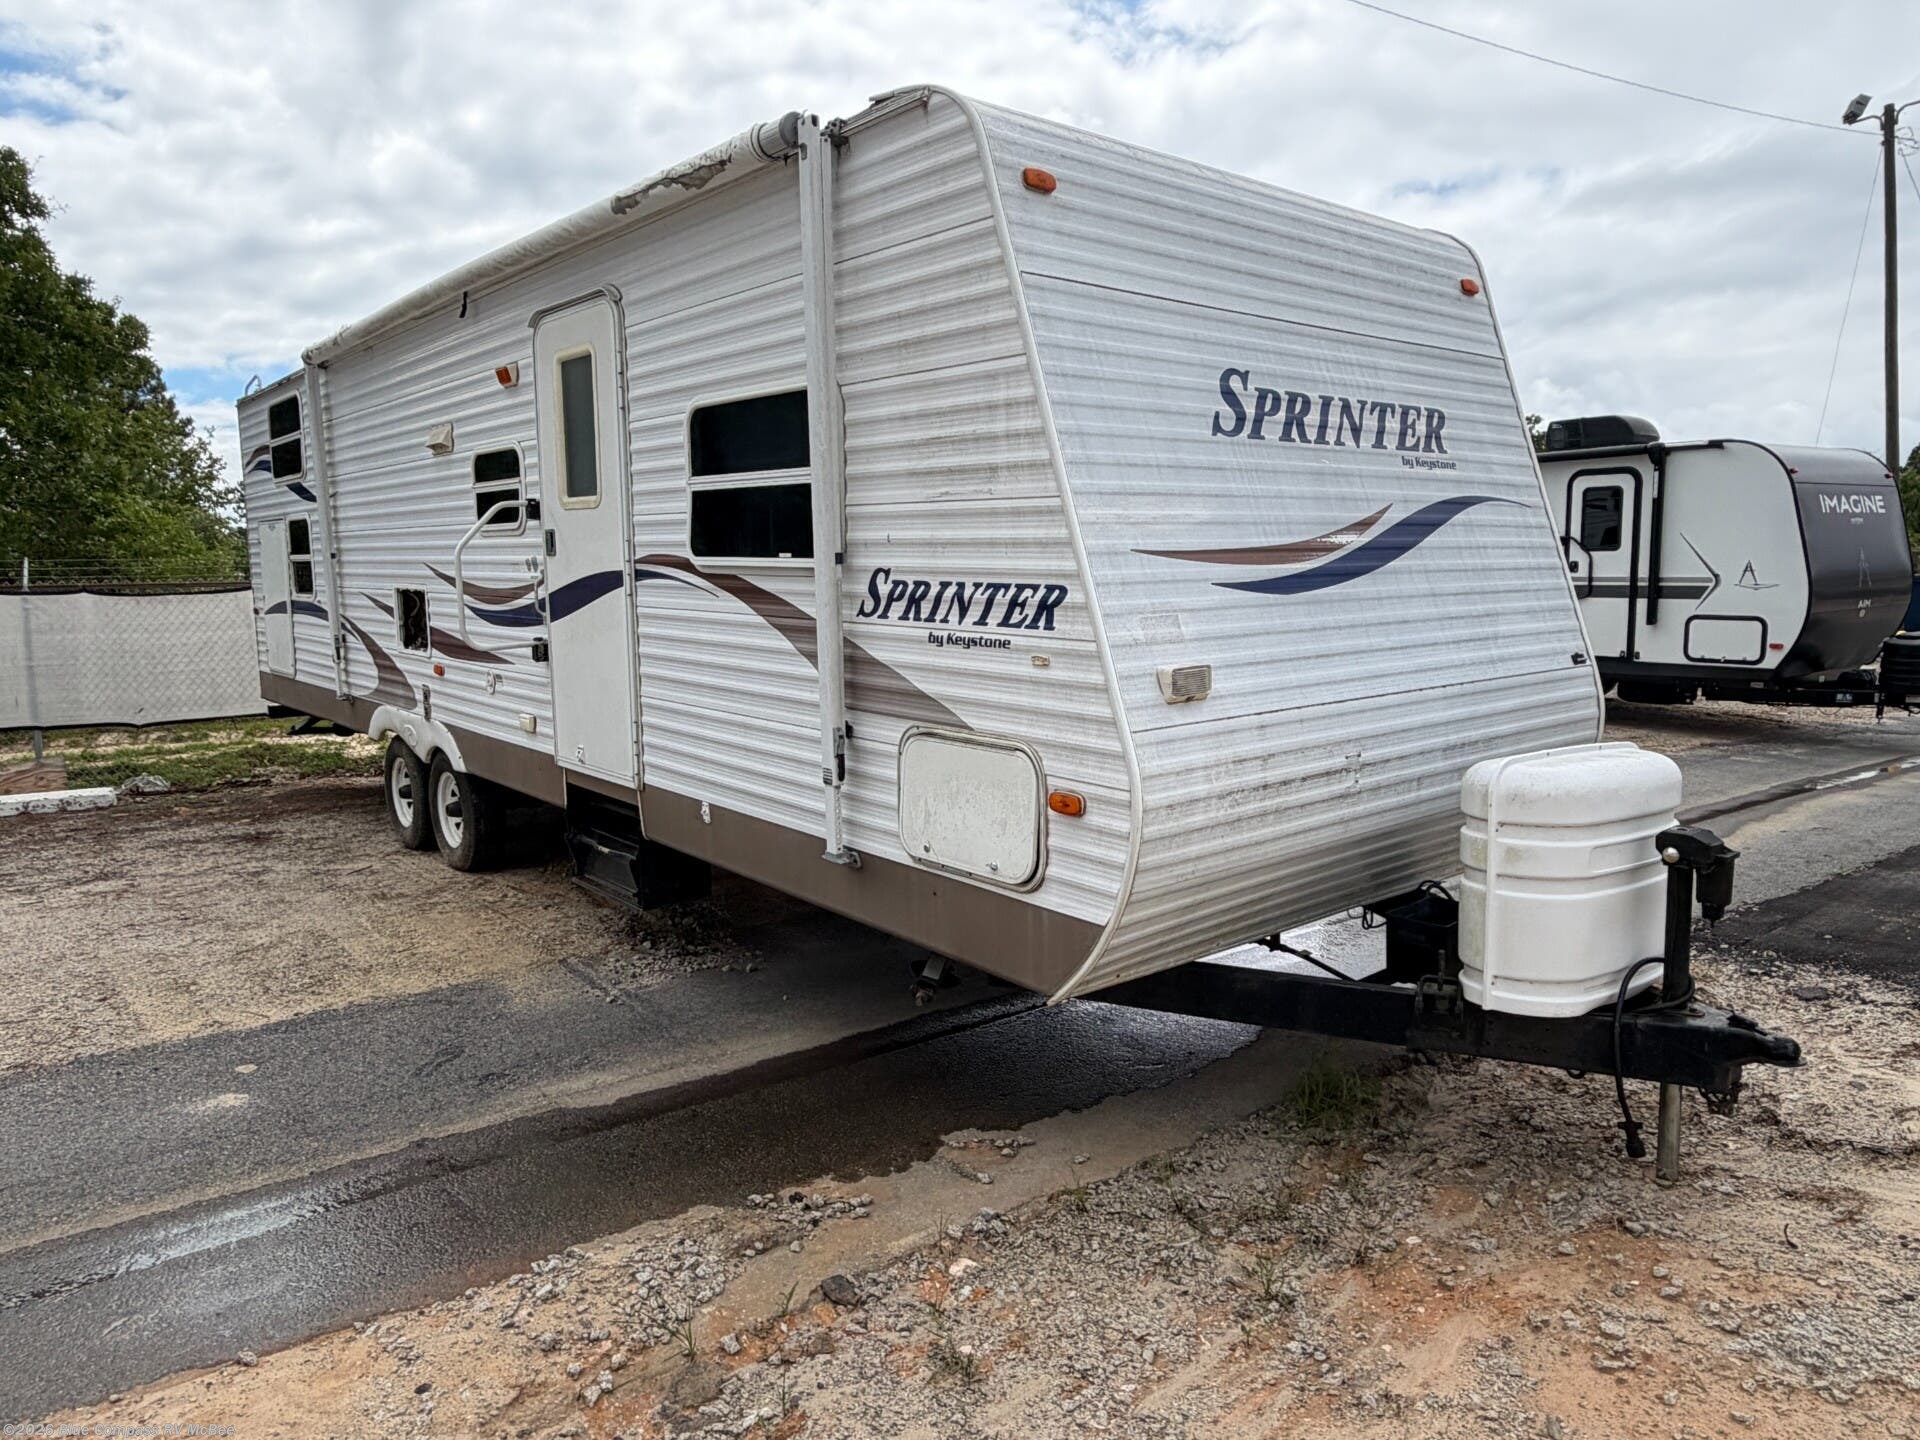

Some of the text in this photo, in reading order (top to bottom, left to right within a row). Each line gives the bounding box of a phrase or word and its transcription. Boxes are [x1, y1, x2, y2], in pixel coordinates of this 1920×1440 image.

[1211, 367, 1449, 454] SPRINTER
[1401, 455, 1457, 471] by Keystone
[1819, 494, 1887, 514] IMAGINE
[856, 567, 1069, 631] SPRINTER
[928, 631, 1012, 650] by Keystone
